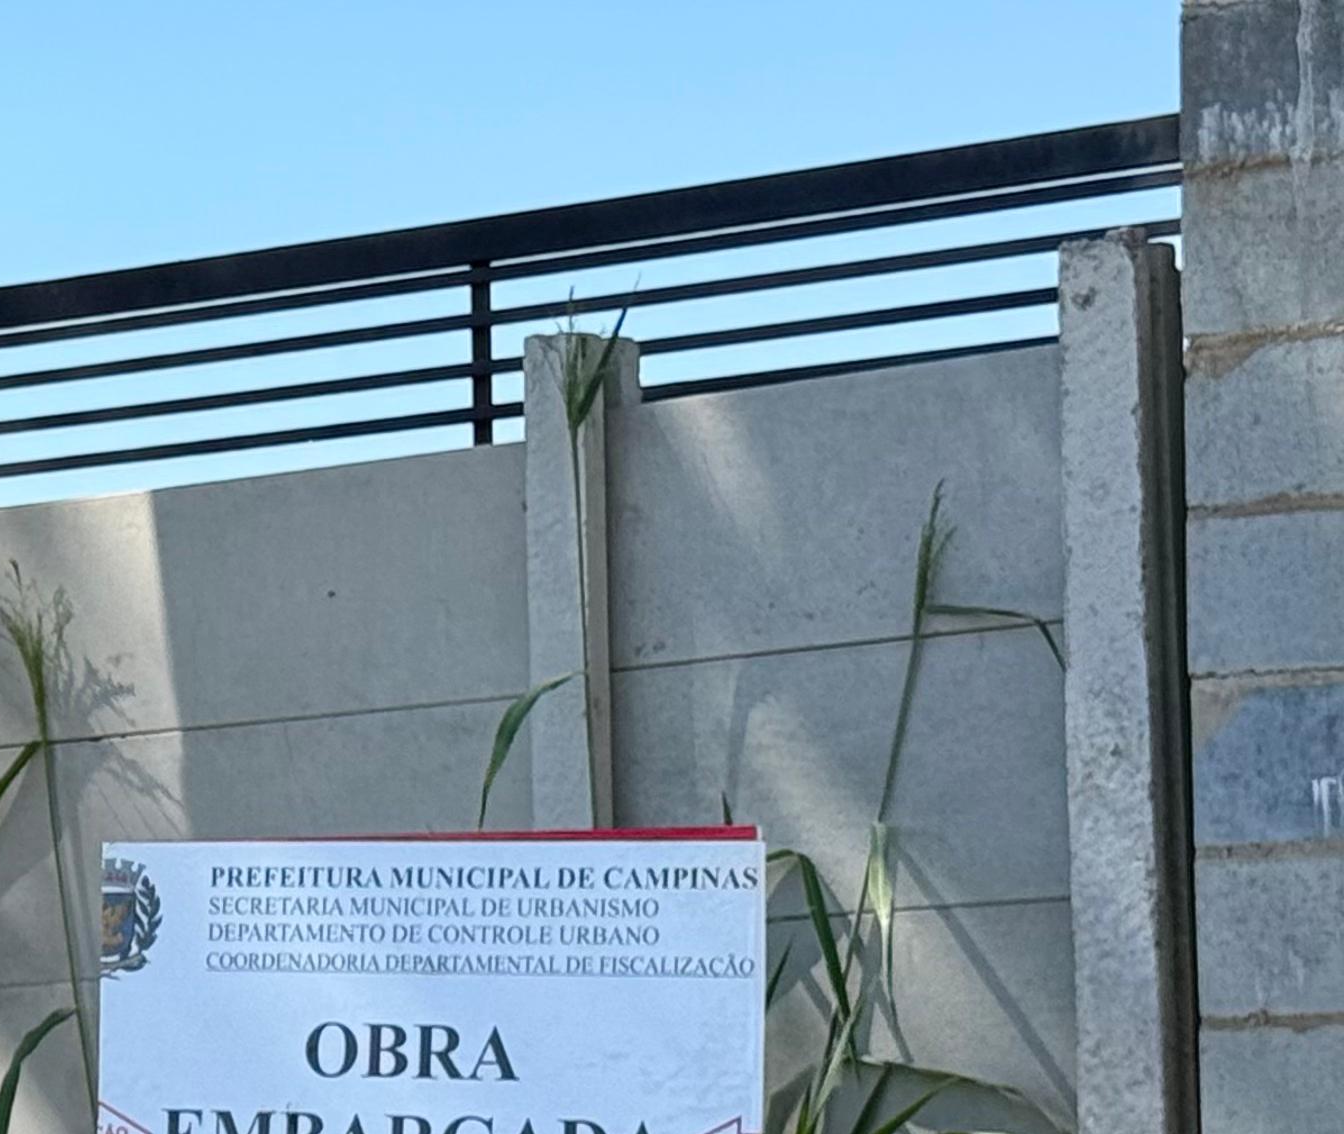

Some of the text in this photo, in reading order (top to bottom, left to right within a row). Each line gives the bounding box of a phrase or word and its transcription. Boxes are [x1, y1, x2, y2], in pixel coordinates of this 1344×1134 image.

[210, 866, 759, 890] PREFEITURA MUNICIPAL DE CAMPINAS
[208, 896, 660, 918] SECRETARIA MUNICIPAL DE URBANISMO
[207, 922, 660, 945] DEPARTAMENTO DE CONTROLE URBANO
[206, 951, 755, 978] COORDENADORIA DEPARTAMENTAL DE FISCALIZAÇÃO
[305, 1021, 520, 1081] OBRA
